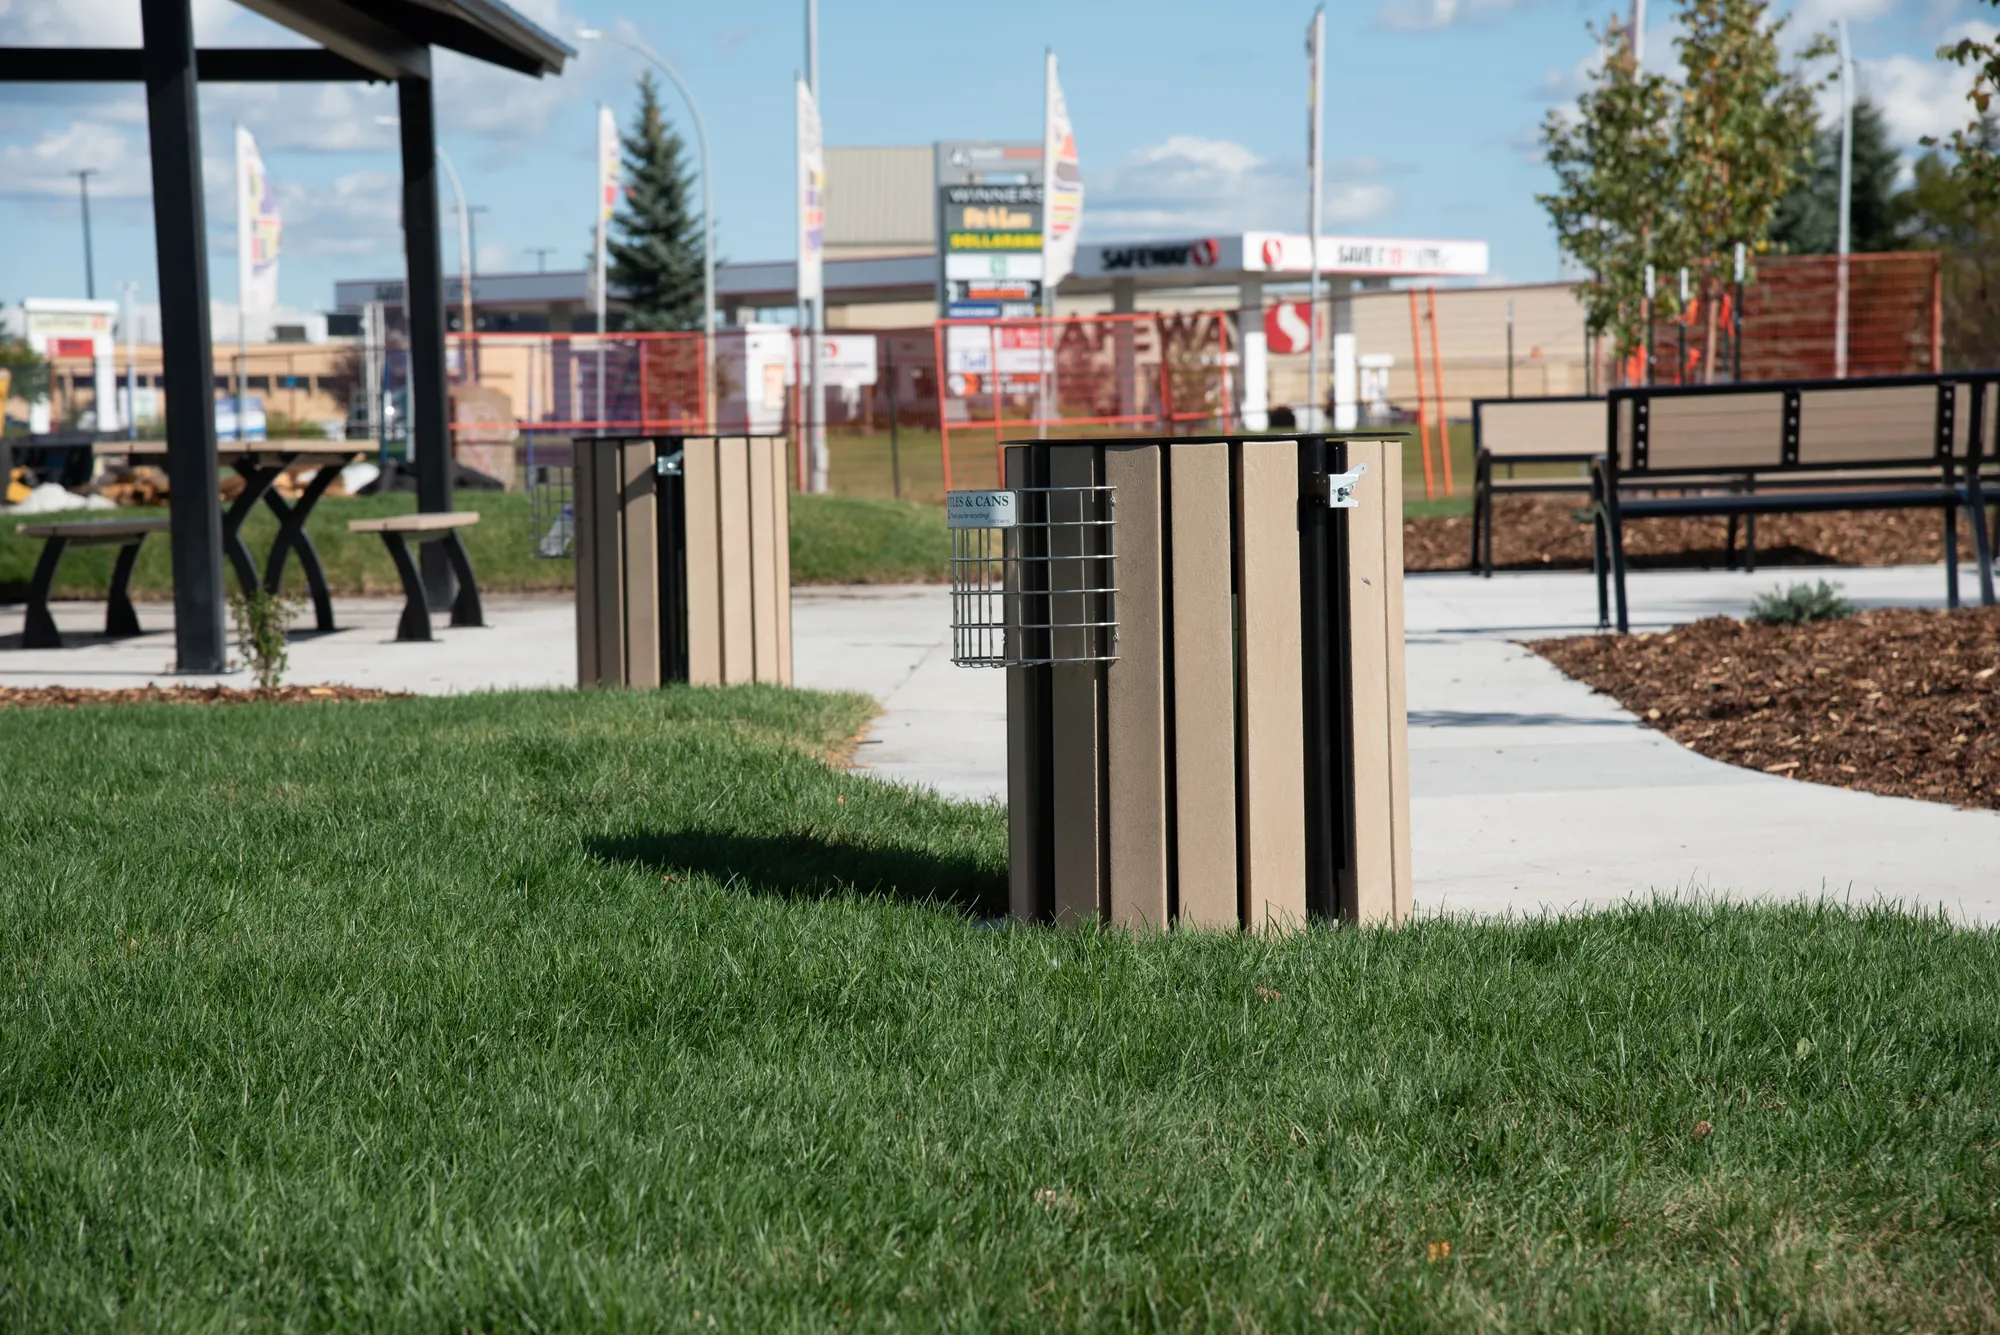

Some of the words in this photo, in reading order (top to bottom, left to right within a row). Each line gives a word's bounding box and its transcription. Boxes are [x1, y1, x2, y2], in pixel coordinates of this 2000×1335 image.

[1102, 244, 1190, 270] SAFEWAY
[965, 495, 974, 508] &
[975, 495, 1009, 507] CANS
